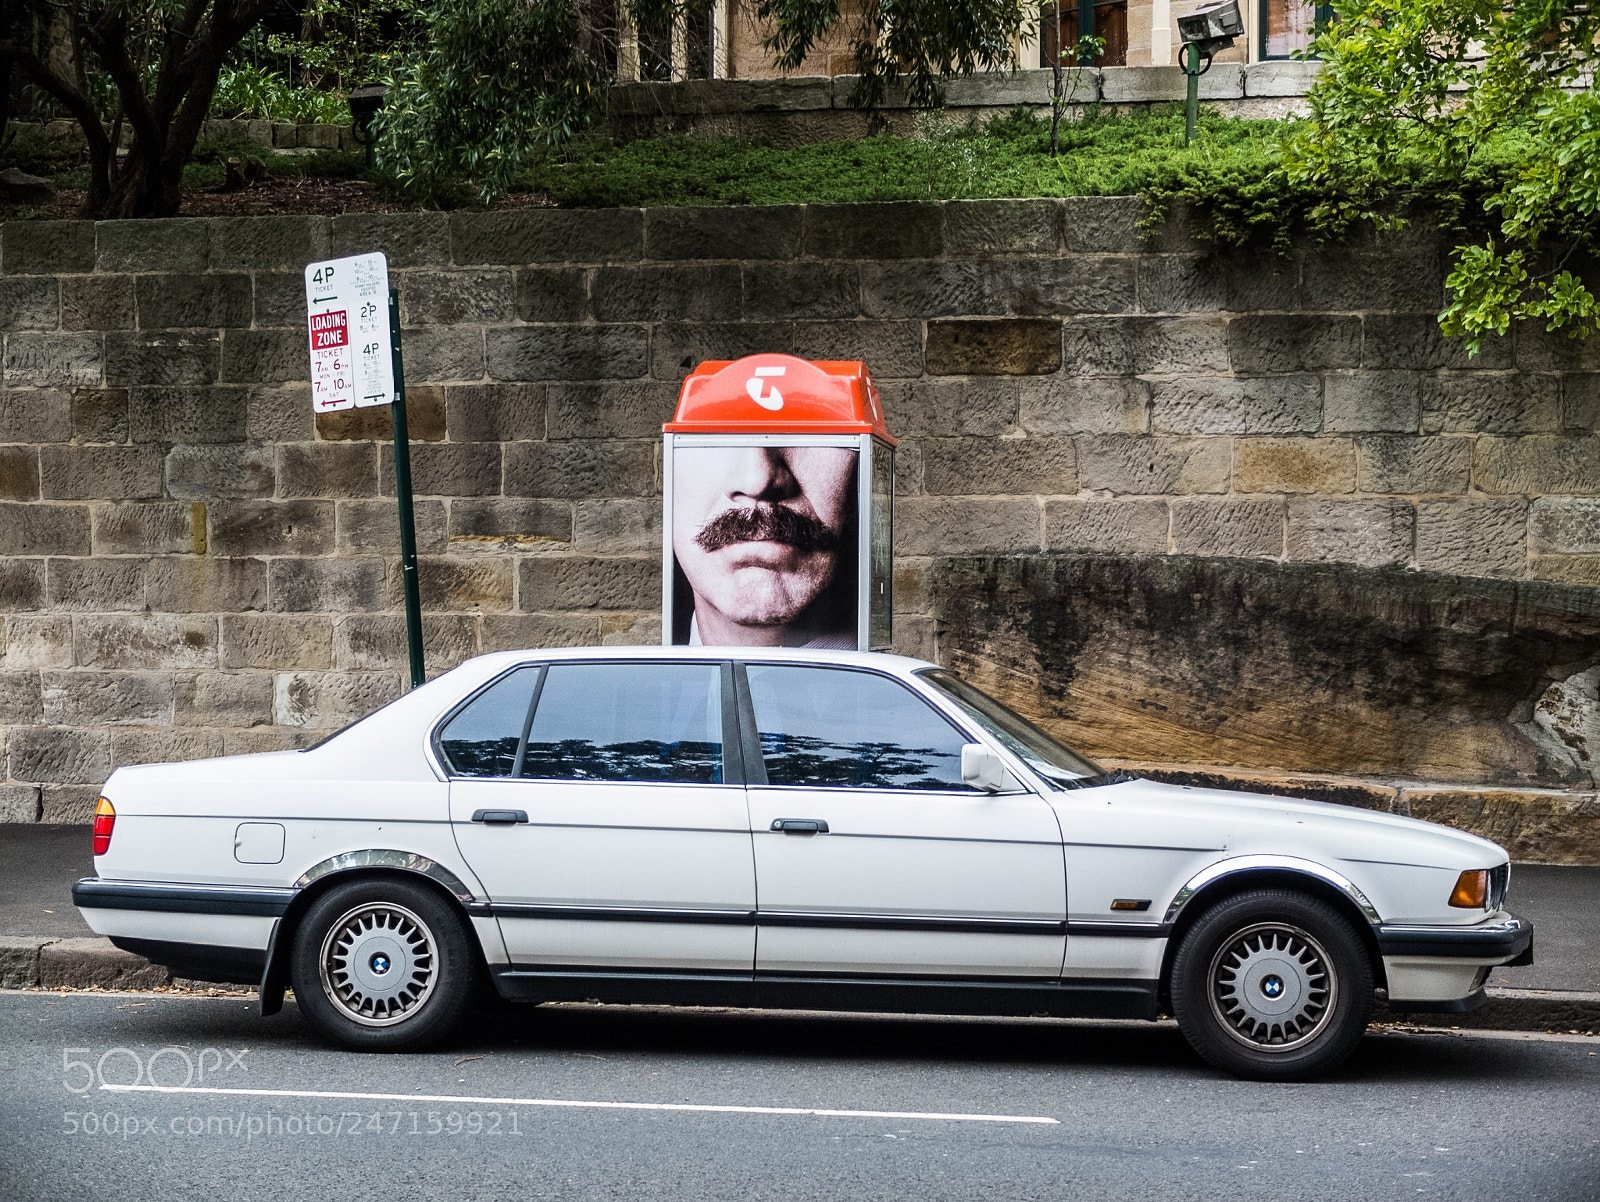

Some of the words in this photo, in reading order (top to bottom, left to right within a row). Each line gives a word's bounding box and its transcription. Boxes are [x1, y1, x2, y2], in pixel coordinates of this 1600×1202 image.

[312, 266, 335, 284] 4P
[315, 284, 333, 292] TICKET
[360, 304, 377, 318] 2P
[311, 312, 346, 331] LOADING
[317, 330, 343, 346] ZONE
[317, 348, 344, 359] TICKET
[363, 342, 379, 355] 4P
